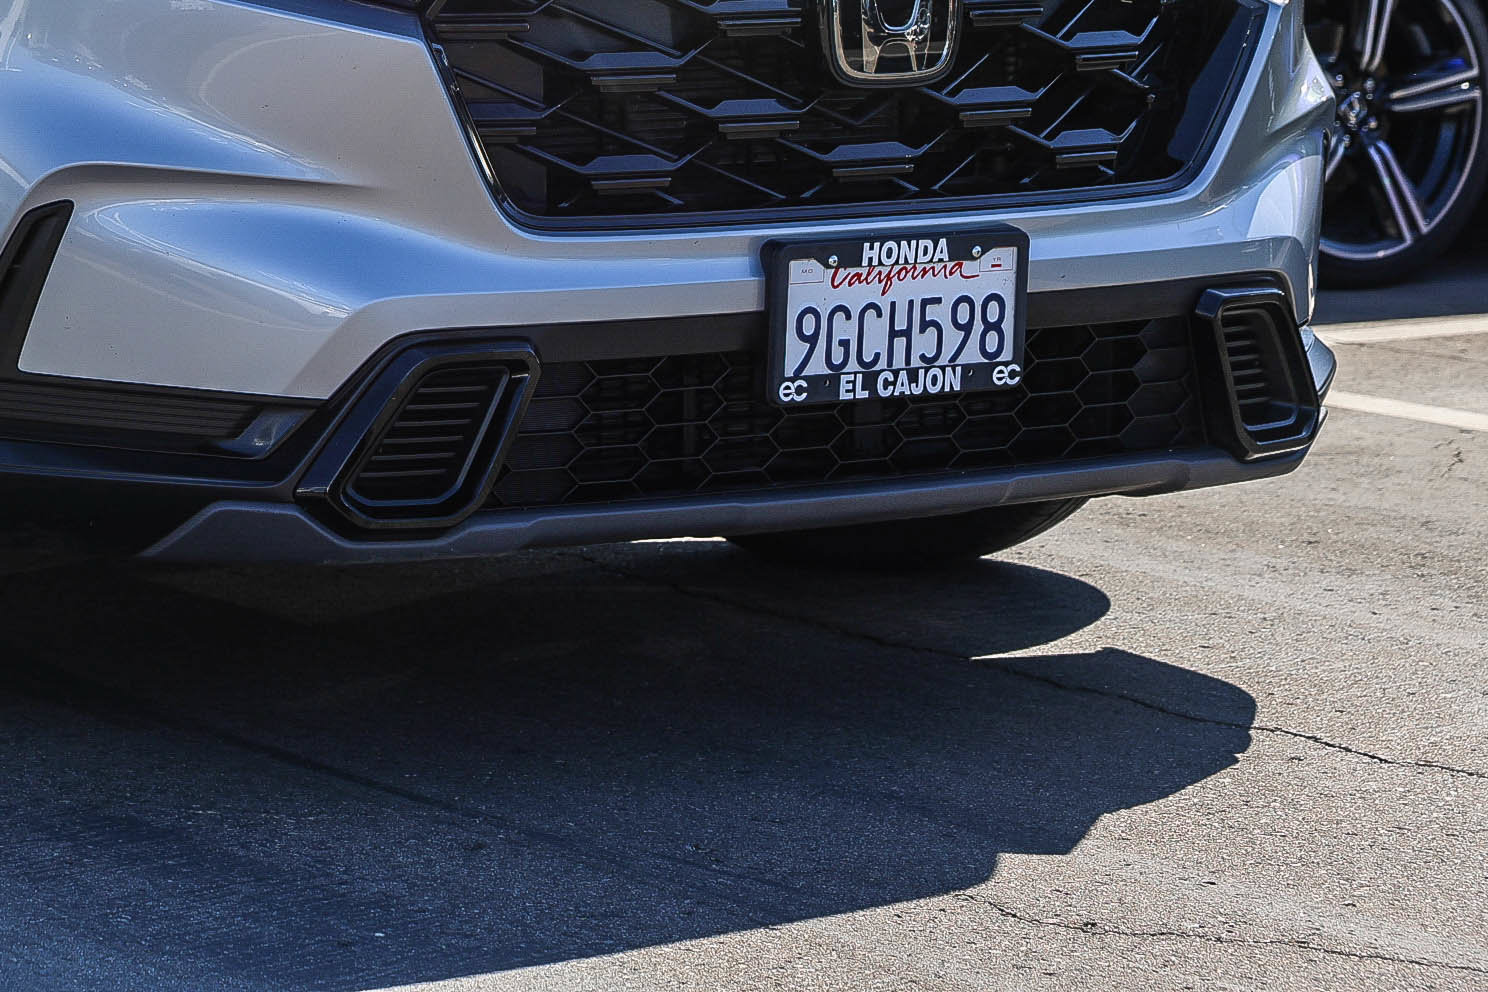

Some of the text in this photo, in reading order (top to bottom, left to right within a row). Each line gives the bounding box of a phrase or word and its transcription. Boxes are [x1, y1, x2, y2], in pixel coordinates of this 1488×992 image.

[861, 238, 949, 267] HONDA
[830, 261, 980, 296] California
[793, 292, 1007, 377] 9GCH598
[839, 366, 962, 400] EL CAJON
